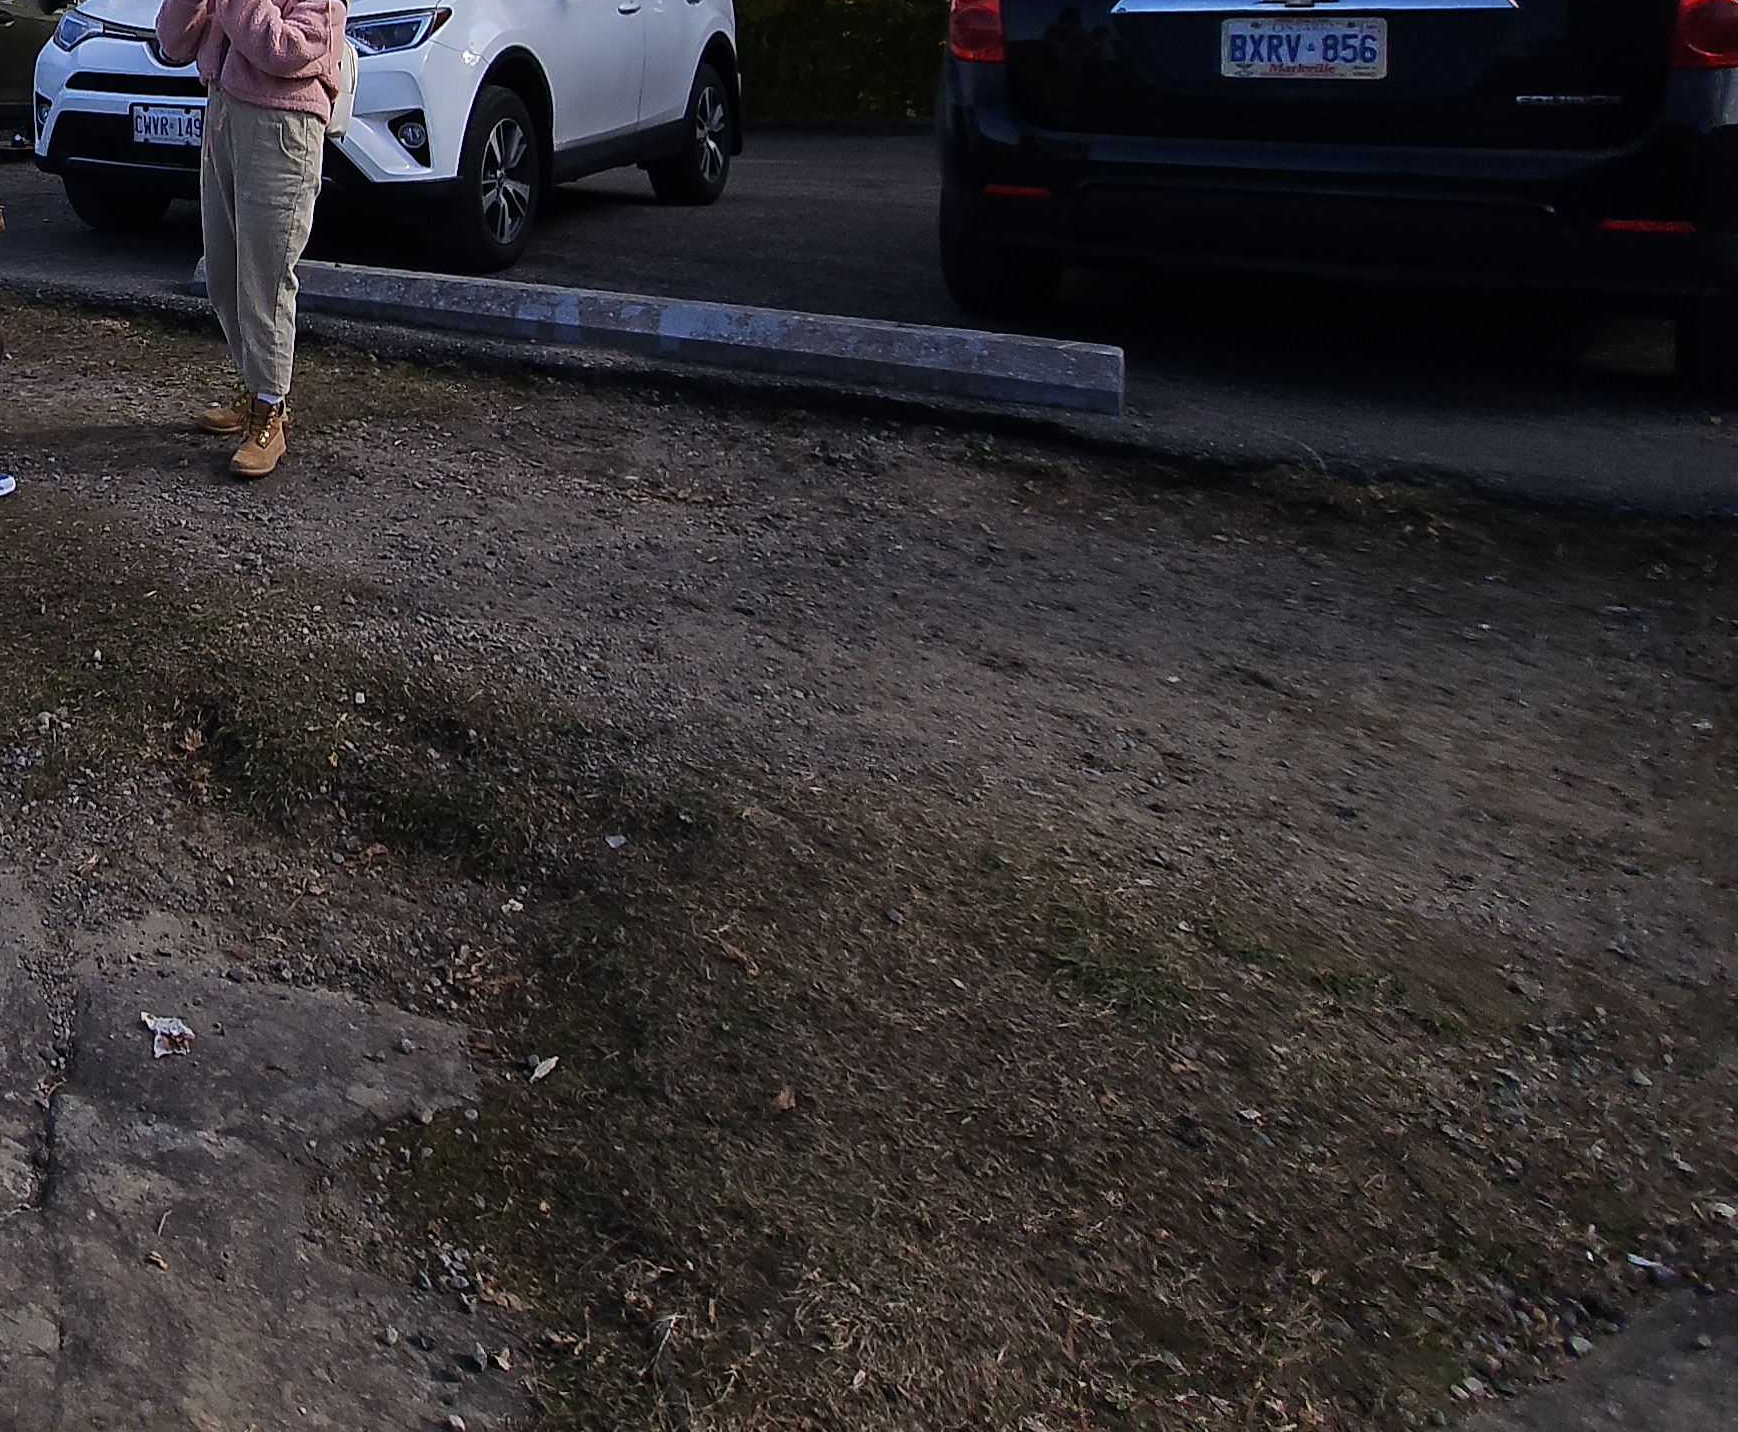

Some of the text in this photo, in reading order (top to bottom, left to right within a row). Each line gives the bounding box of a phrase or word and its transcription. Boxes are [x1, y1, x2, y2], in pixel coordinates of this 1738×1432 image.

[1230, 34, 1377, 63] BXRV 856
[177, 117, 201, 138] 149
